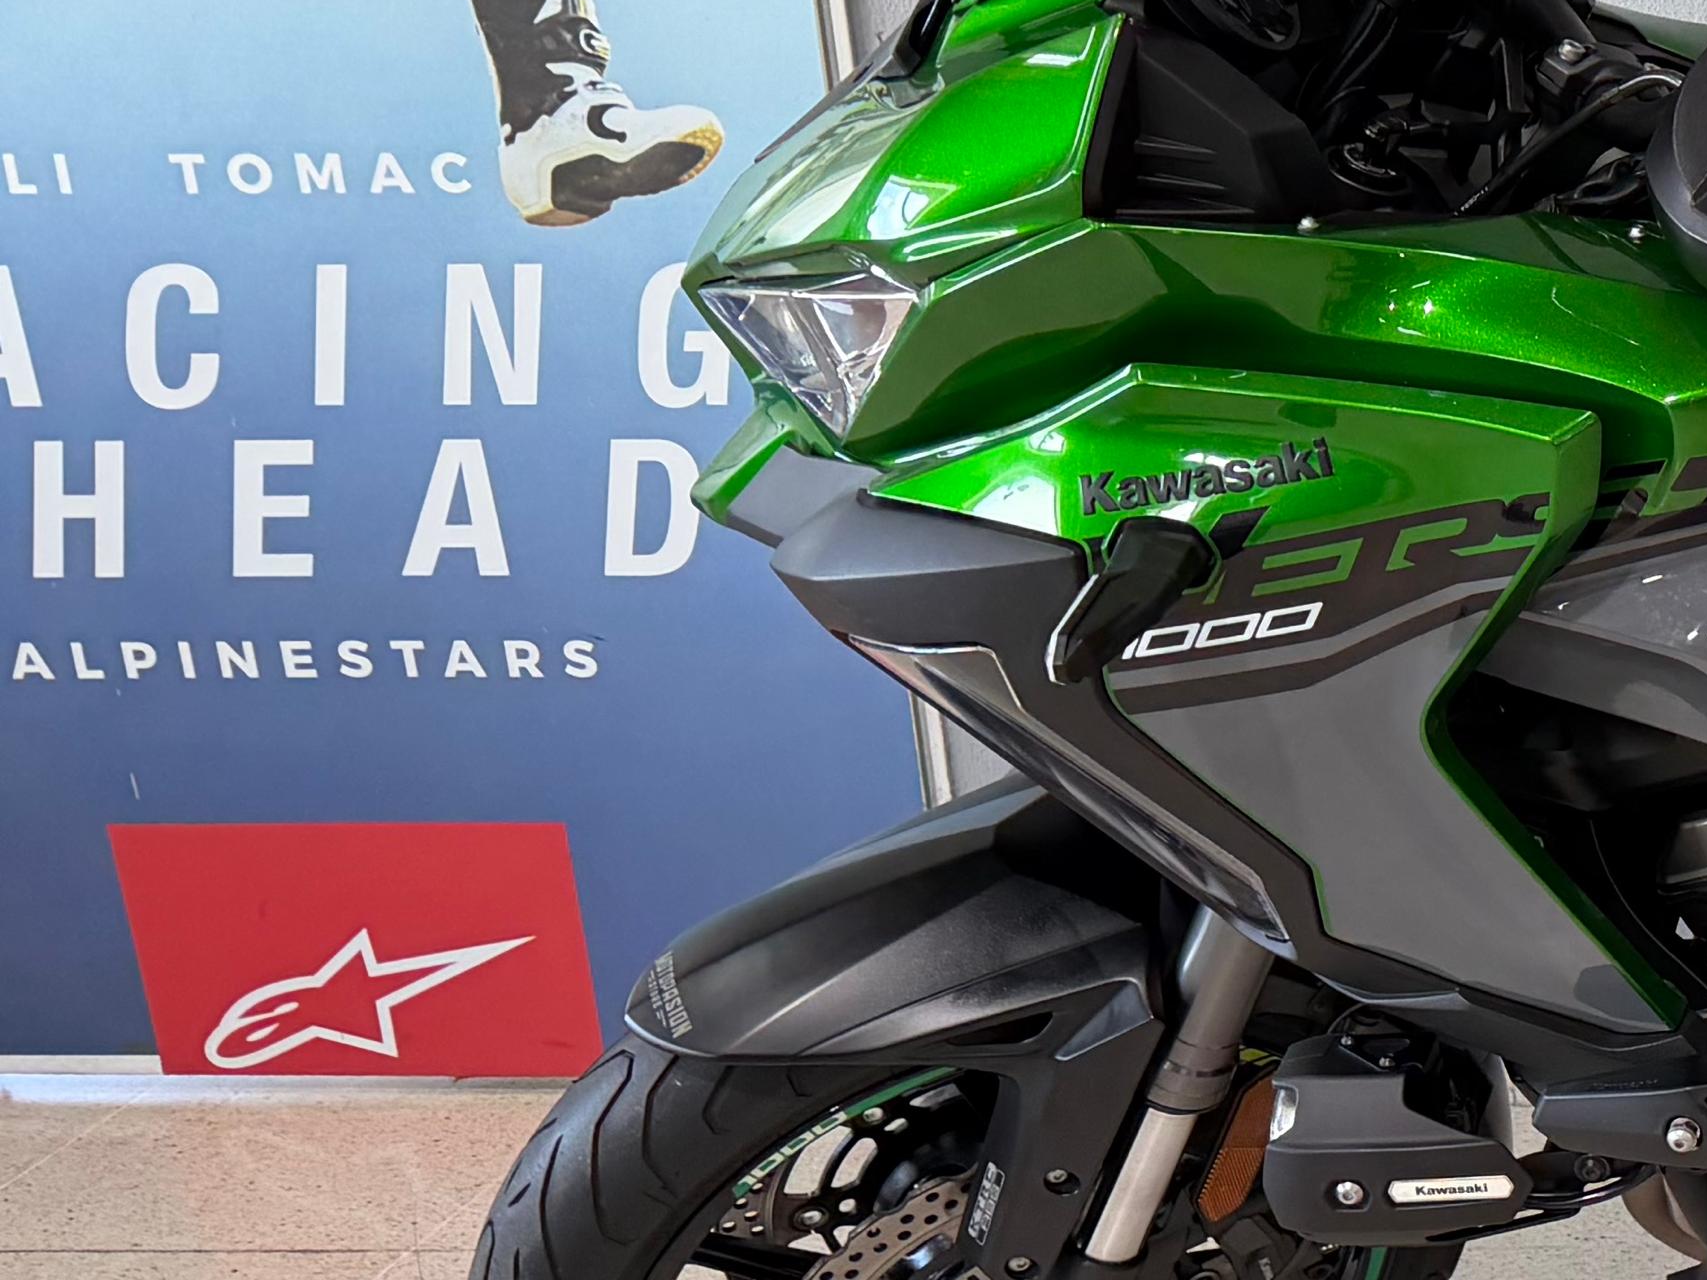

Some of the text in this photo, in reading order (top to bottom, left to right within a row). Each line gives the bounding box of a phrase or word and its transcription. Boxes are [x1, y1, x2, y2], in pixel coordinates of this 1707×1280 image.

[167, 152, 473, 195] TOMAC
[1079, 437, 1336, 516] Kawasaki
[32, 438, 700, 579] HEAD
[12, 639, 599, 681] ALPINESTARS
[1414, 1182, 1489, 1197] Kawasaki
